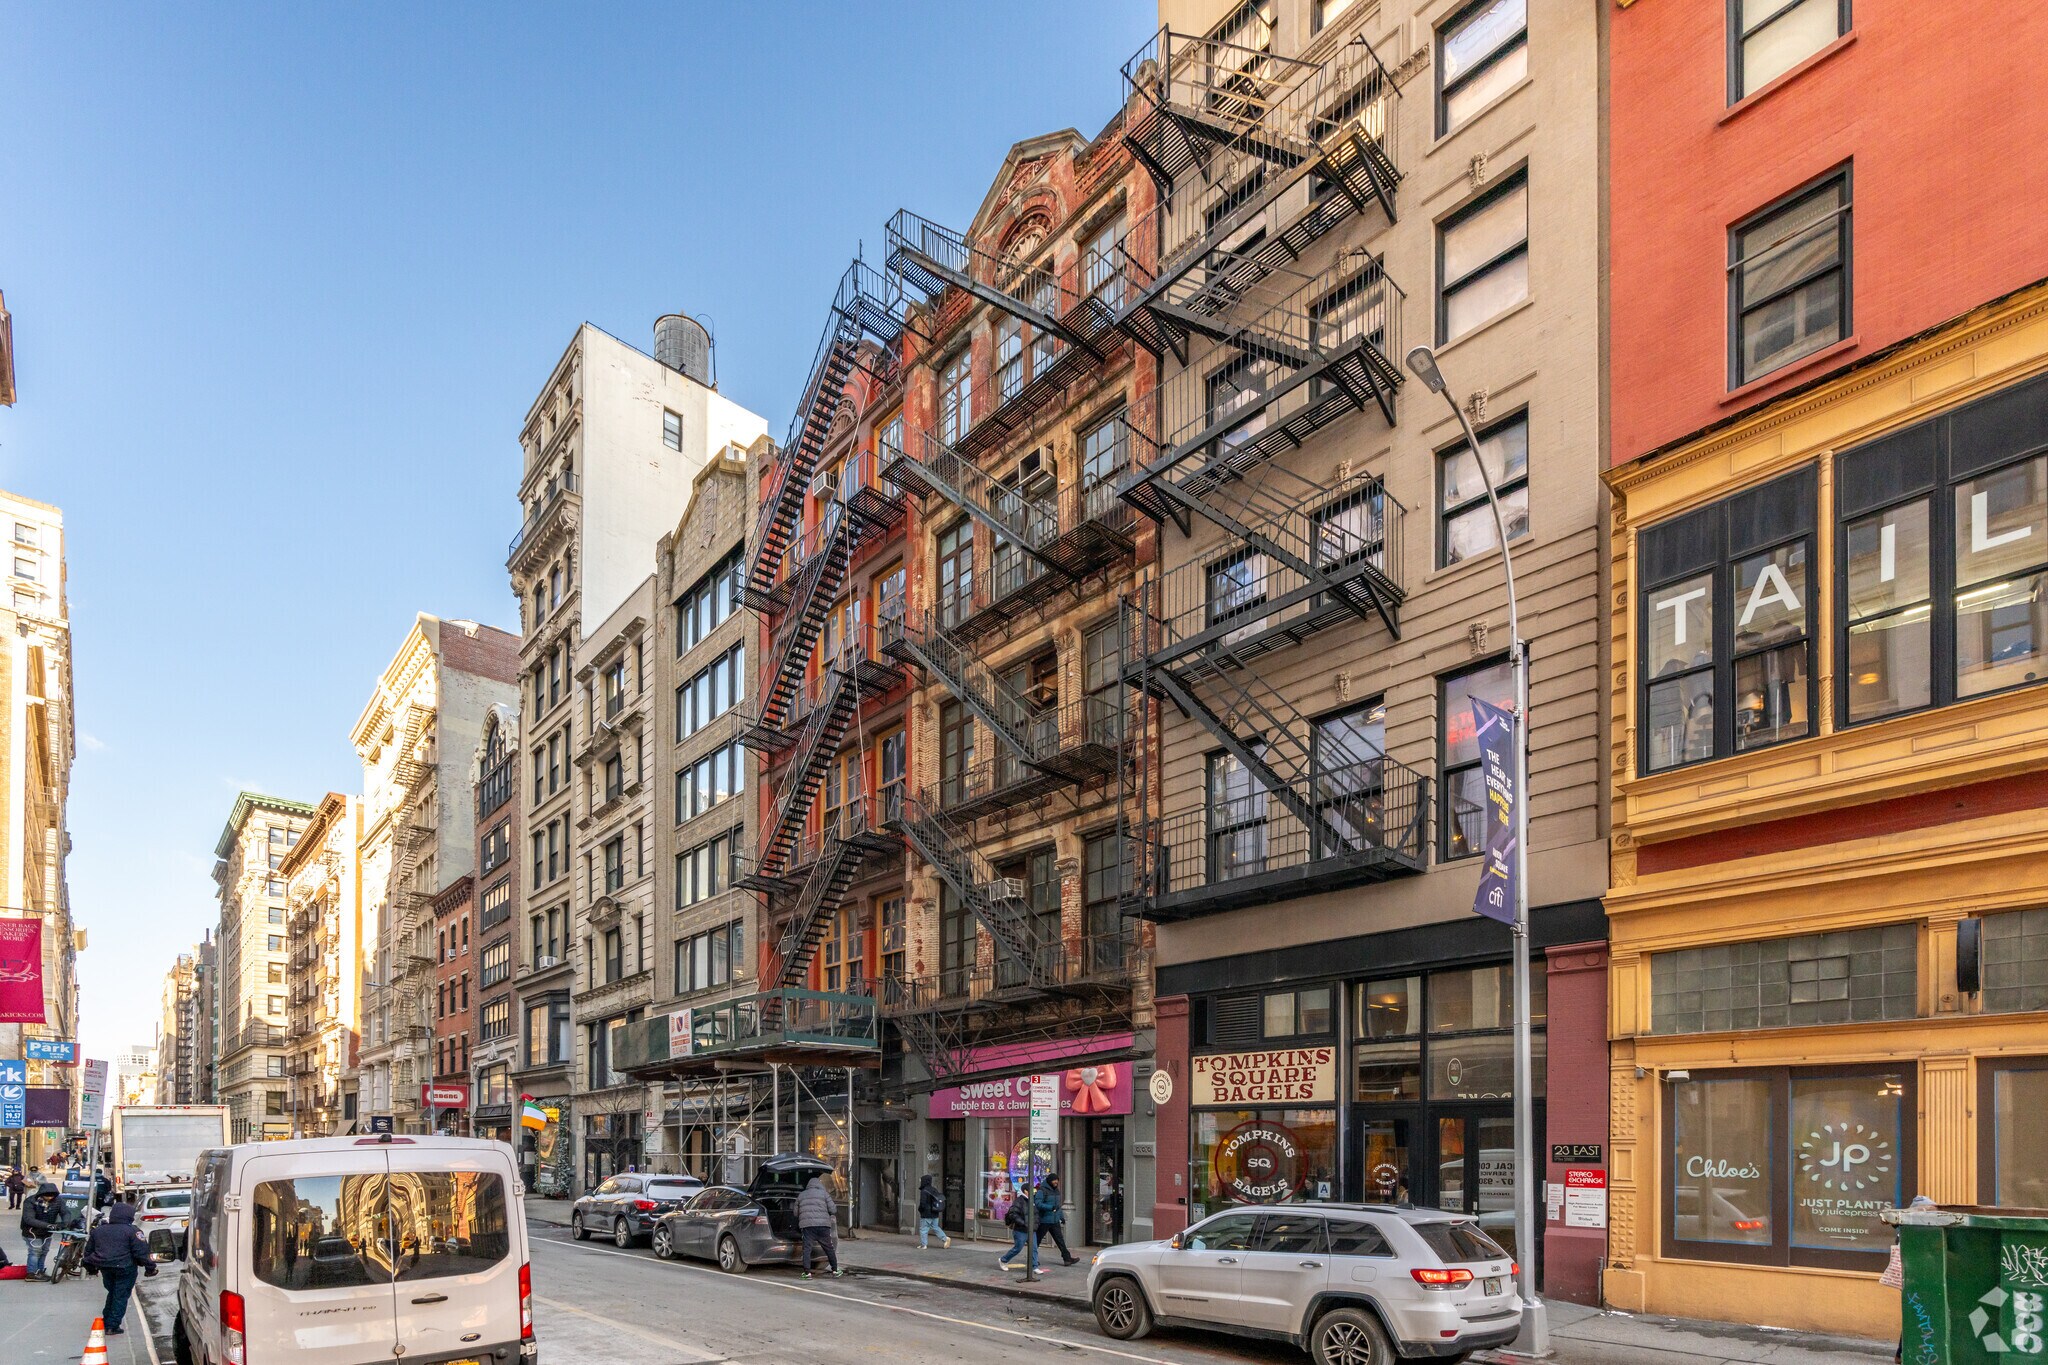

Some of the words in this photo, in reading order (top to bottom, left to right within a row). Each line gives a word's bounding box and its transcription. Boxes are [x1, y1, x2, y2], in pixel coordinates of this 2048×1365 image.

[1486, 748, 1500, 765] THE
[1488, 886, 1505, 908] citi
[30, 1042, 71, 1054] Park
[1194, 1049, 1331, 1073] TOMPKINS
[1034, 1076, 1039, 1084] 3
[1211, 1066, 1317, 1087] SQUARE
[960, 1078, 1012, 1100] Sweet
[1213, 1083, 1314, 1103] BAGELS
[951, 1101, 979, 1111] bubble
[981, 1101, 995, 1110] tea
[998, 1101, 1005, 1110] &
[1225, 1130, 1295, 1158] TOMPKINS
[1554, 1145, 1570, 1155] 23
[1573, 1145, 1599, 1156] EAST
[1247, 1158, 1272, 1169] SQ
[1819, 1142, 1870, 1172] JP
[1373, 1163, 1399, 1174] TOMPKINS
[1686, 1156, 1760, 1179] Chloe's
[1232, 1178, 1288, 1196] BAGELS
[1320, 1184, 1328, 1194] A
[1800, 1198, 1833, 1208] JUST
[1836, 1199, 1893, 1210] PLANTS
[1811, 1207, 1824, 1216] by
[1826, 1208, 1879, 1217] juicepress
